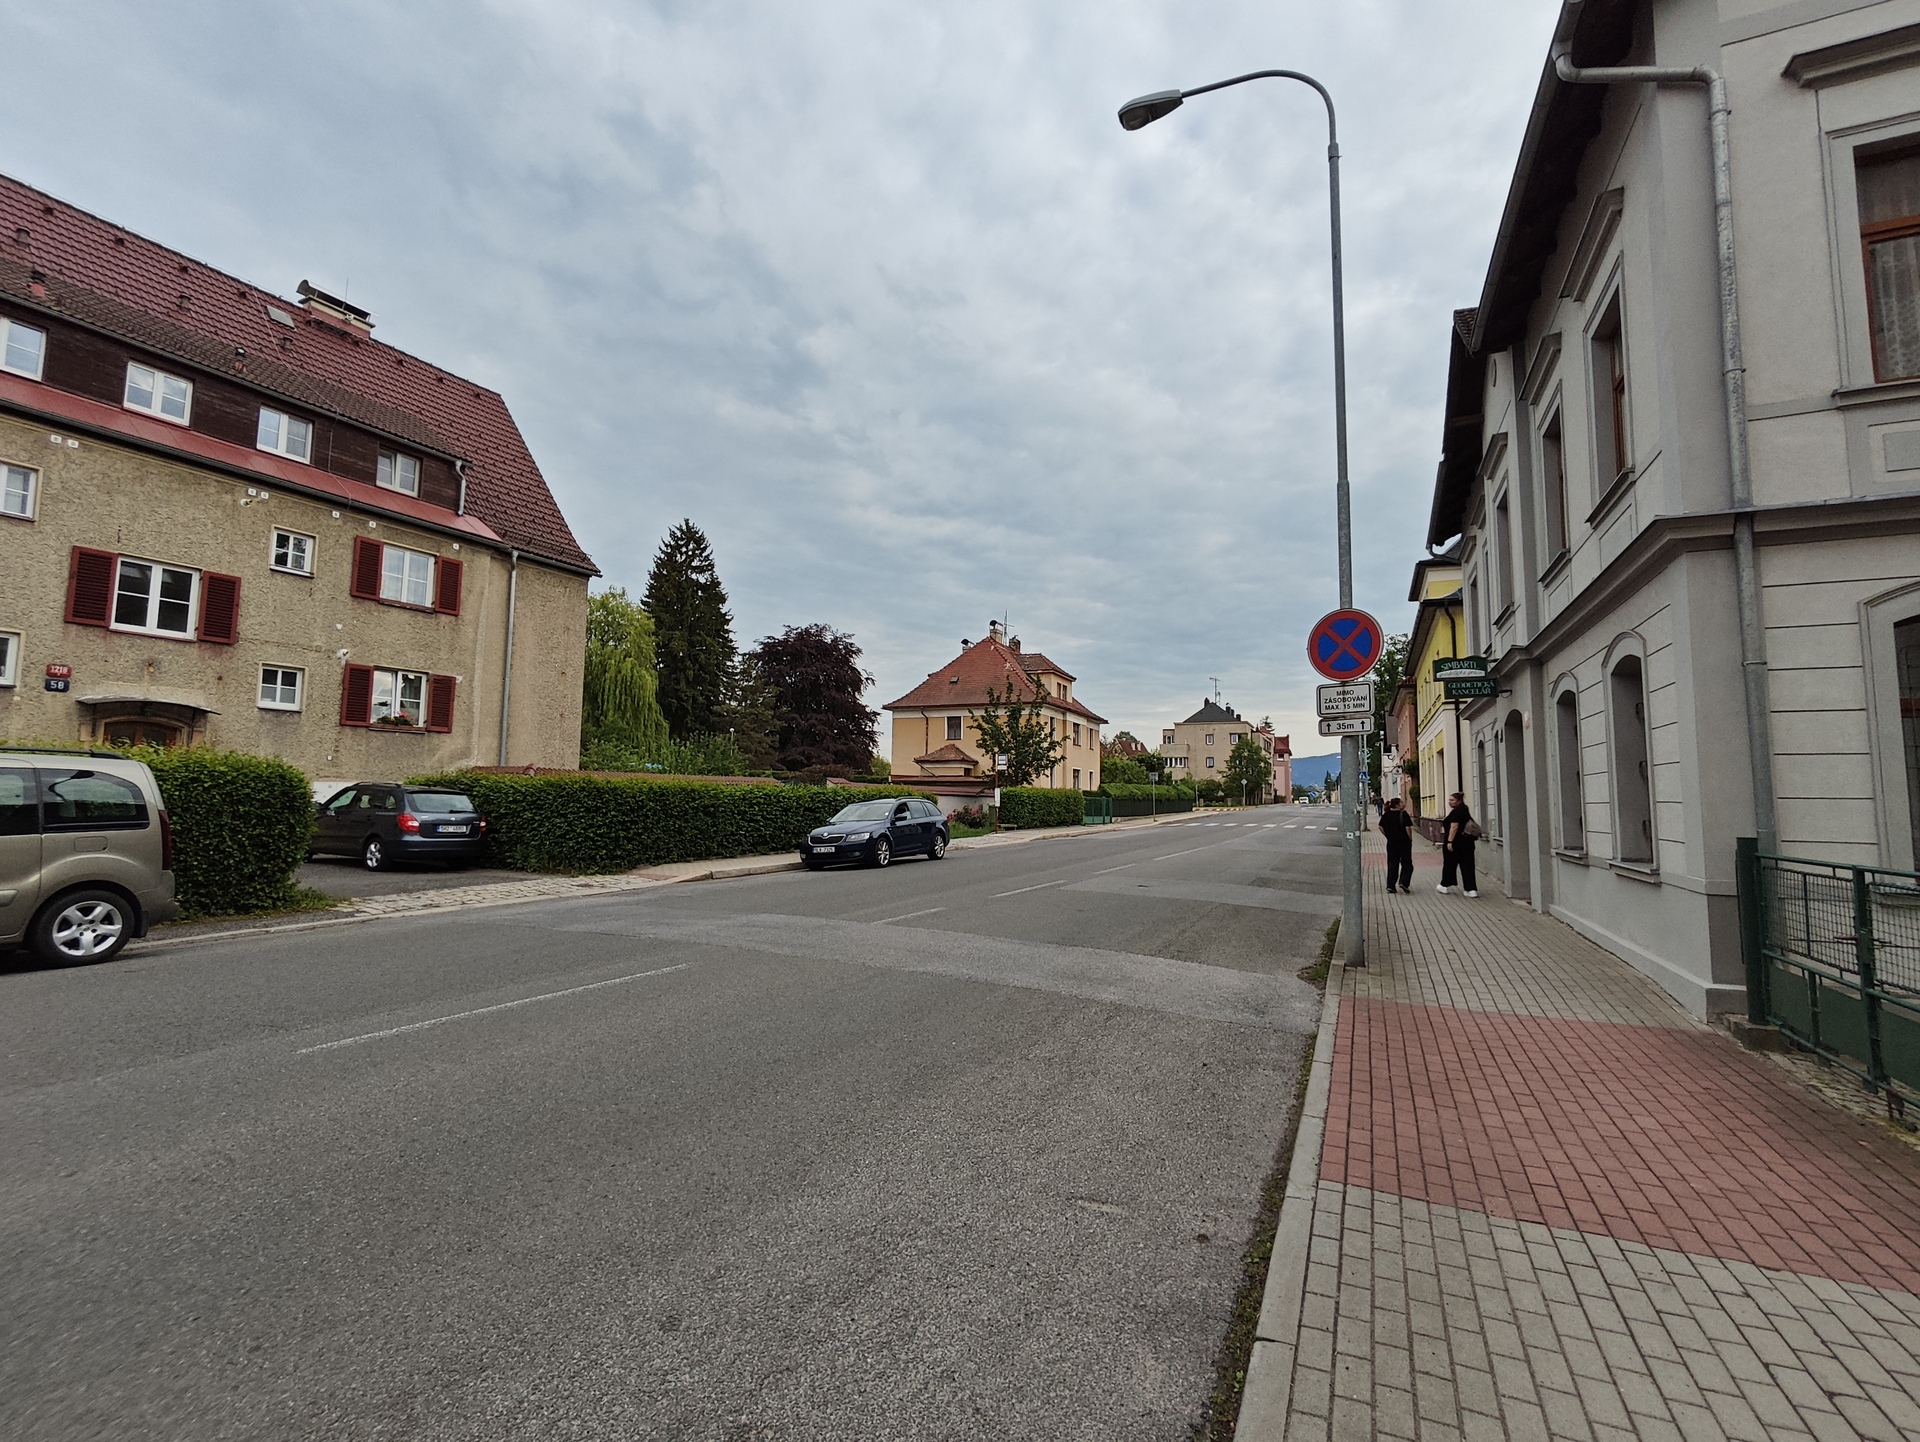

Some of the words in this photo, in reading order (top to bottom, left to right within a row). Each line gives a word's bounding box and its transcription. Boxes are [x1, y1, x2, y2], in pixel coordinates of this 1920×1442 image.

[50, 681, 65, 690] 58
[1448, 680, 1495, 689] GEODETICKÁ
[1452, 686, 1491, 695] KANCELÁŘ
[1324, 694, 1368, 704] ZÁSOBOVÁNÍ
